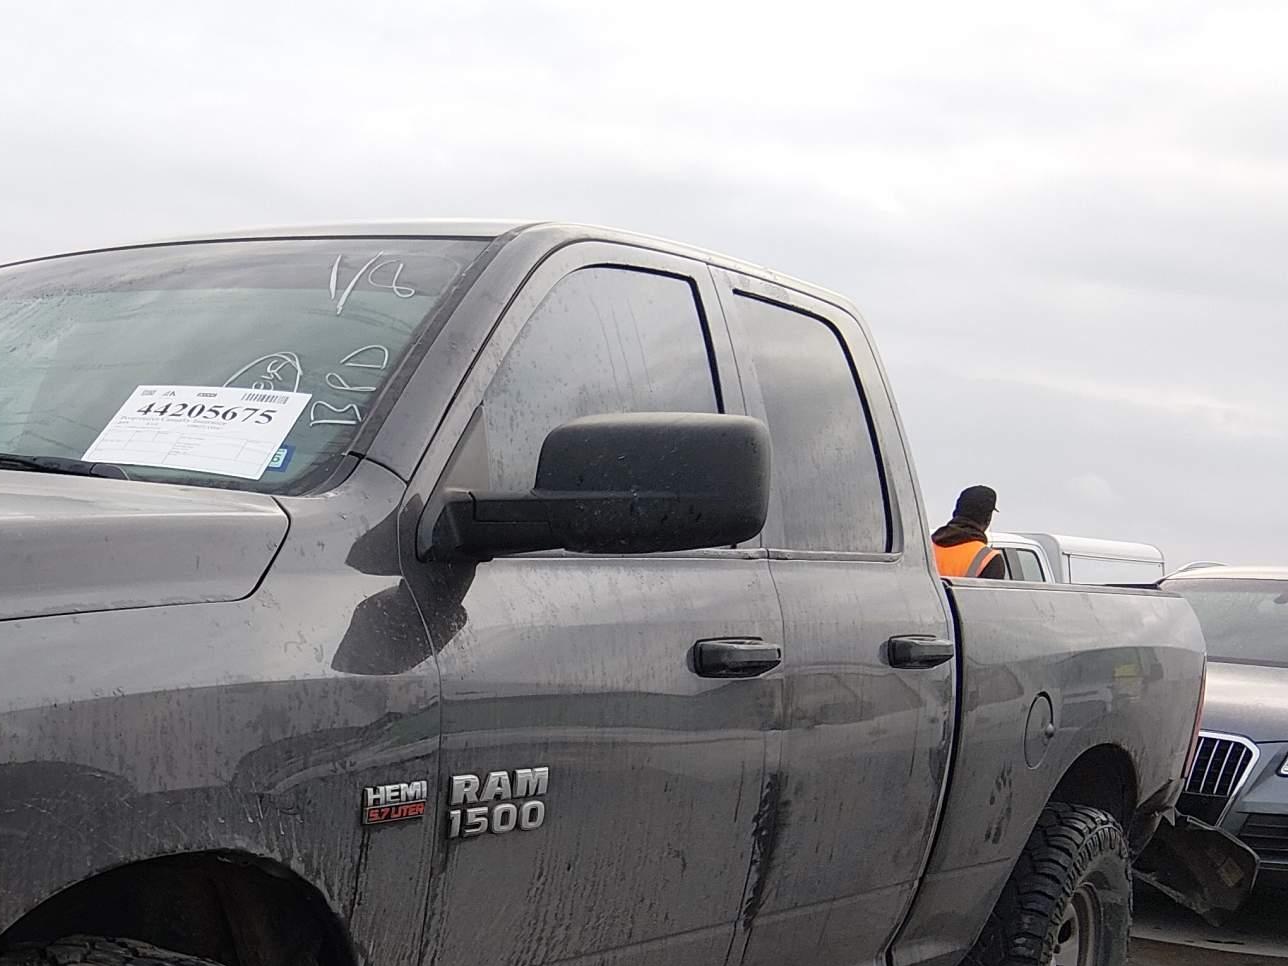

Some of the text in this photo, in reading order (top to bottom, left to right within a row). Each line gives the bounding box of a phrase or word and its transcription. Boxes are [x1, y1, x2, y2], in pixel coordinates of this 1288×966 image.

[137, 401, 277, 425] 44205675
[364, 780, 427, 806] HEMI
[450, 766, 549, 805] RAM
[368, 803, 425, 822] 5.7 LITER
[449, 800, 545, 839] 1500
